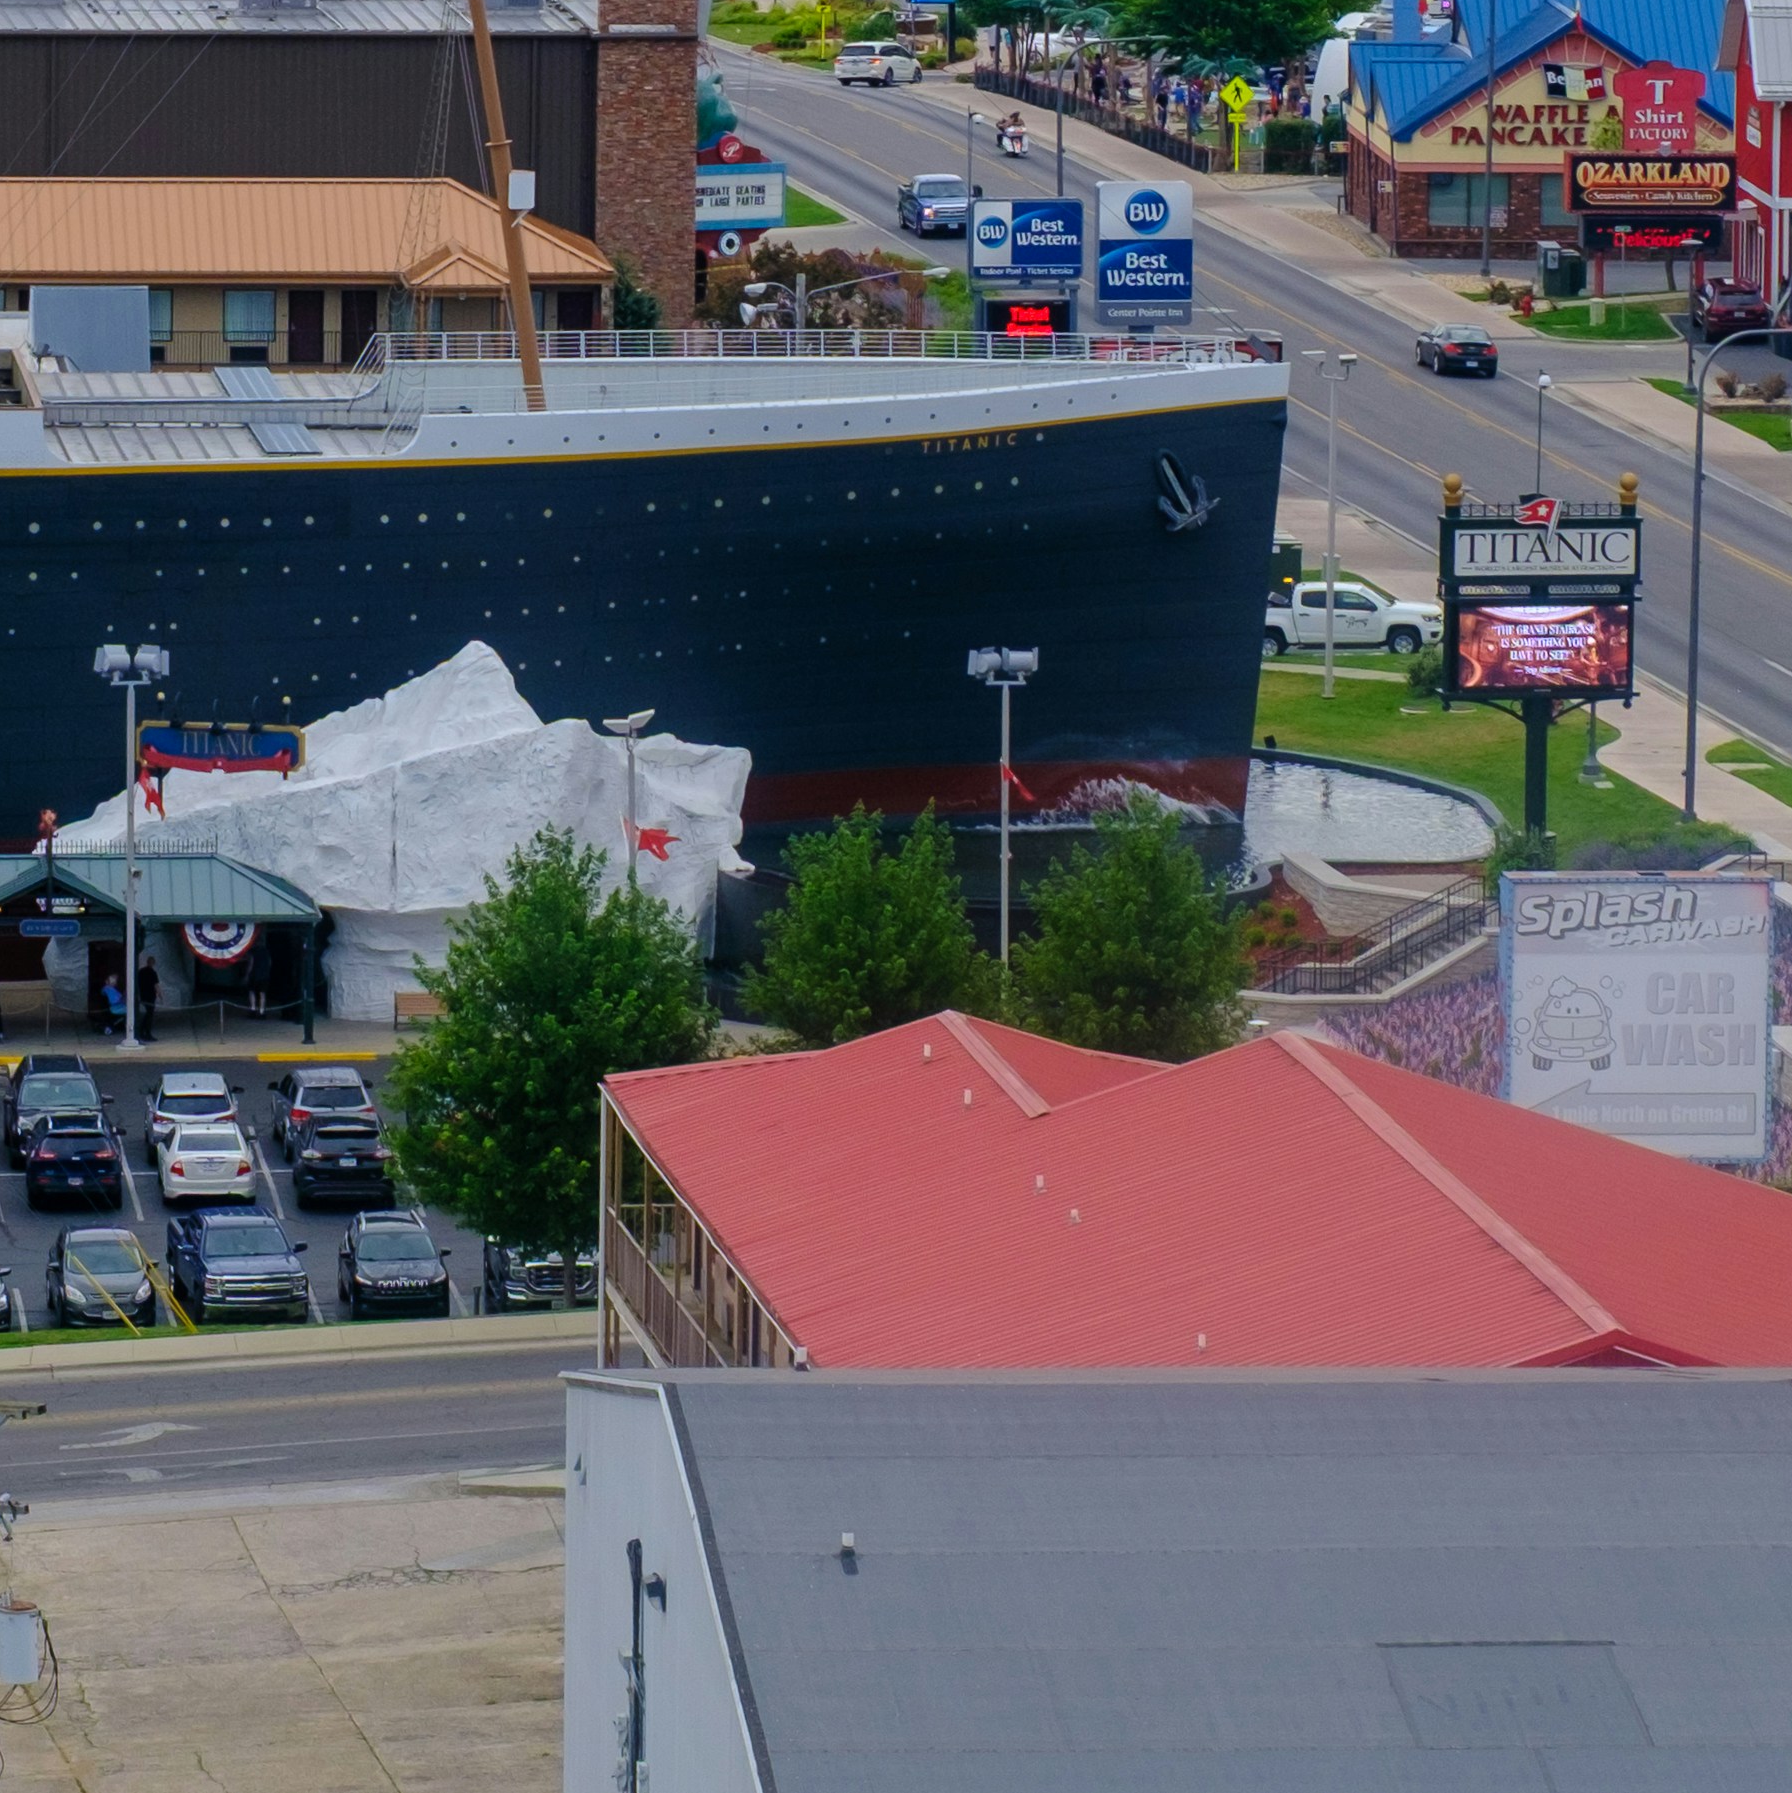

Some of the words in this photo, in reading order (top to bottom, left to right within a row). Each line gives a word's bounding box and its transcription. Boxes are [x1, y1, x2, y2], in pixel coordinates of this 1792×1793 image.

[1645, 79, 1673, 105] T
[1486, 104, 1590, 124] WAFFLE
[1634, 109, 1684, 124] Shirt
[1450, 126, 1588, 146] PANCAKE
[1628, 127, 1690, 140] FACTORY
[1576, 161, 1731, 188] OZARKLAND
[736, 195, 766, 207] PARTIES
[1593, 191, 1639, 200] Souvenirs
[1645, 191, 1675, 202] Candy
[1676, 190, 1713, 201] Kitchen
[1128, 202, 1166, 222] BW
[978, 223, 1006, 240] BW
[1031, 218, 1064, 232] Best
[1016, 231, 1078, 246] Western
[1125, 252, 1168, 269] Best
[980, 267, 1004, 275] Indoor
[1005, 267, 1022, 275] Pool
[1026, 267, 1048, 275] Ticket
[1106, 269, 1185, 286] Western
[1107, 307, 1137, 319] Center
[1138, 307, 1167, 319] Pointe
[1168, 307, 1184, 318] Inn
[921, 432, 1018, 454] TITANIC
[1459, 531, 1631, 564] TITANIC
[1516, 624, 1548, 636] GRAND
[1549, 624, 1595, 636] STAIRCASE
[1500, 637, 1510, 649] IS
[1510, 637, 1565, 649] SOMETHING
[1566, 637, 1587, 649] YOU
[1510, 650, 1534, 661] HAVE
[1535, 650, 1547, 661] TO
[180, 731, 262, 757] TITANIC
[1516, 884, 1698, 941] Splash
[1607, 914, 1767, 948] CARWASH
[1644, 971, 1736, 1015] CAR
[1619, 1023, 1757, 1067] WASH
[1601, 1104, 1645, 1123] North
[1647, 1107, 1668, 1123] on
[1671, 1104, 1724, 1123] Gretna
